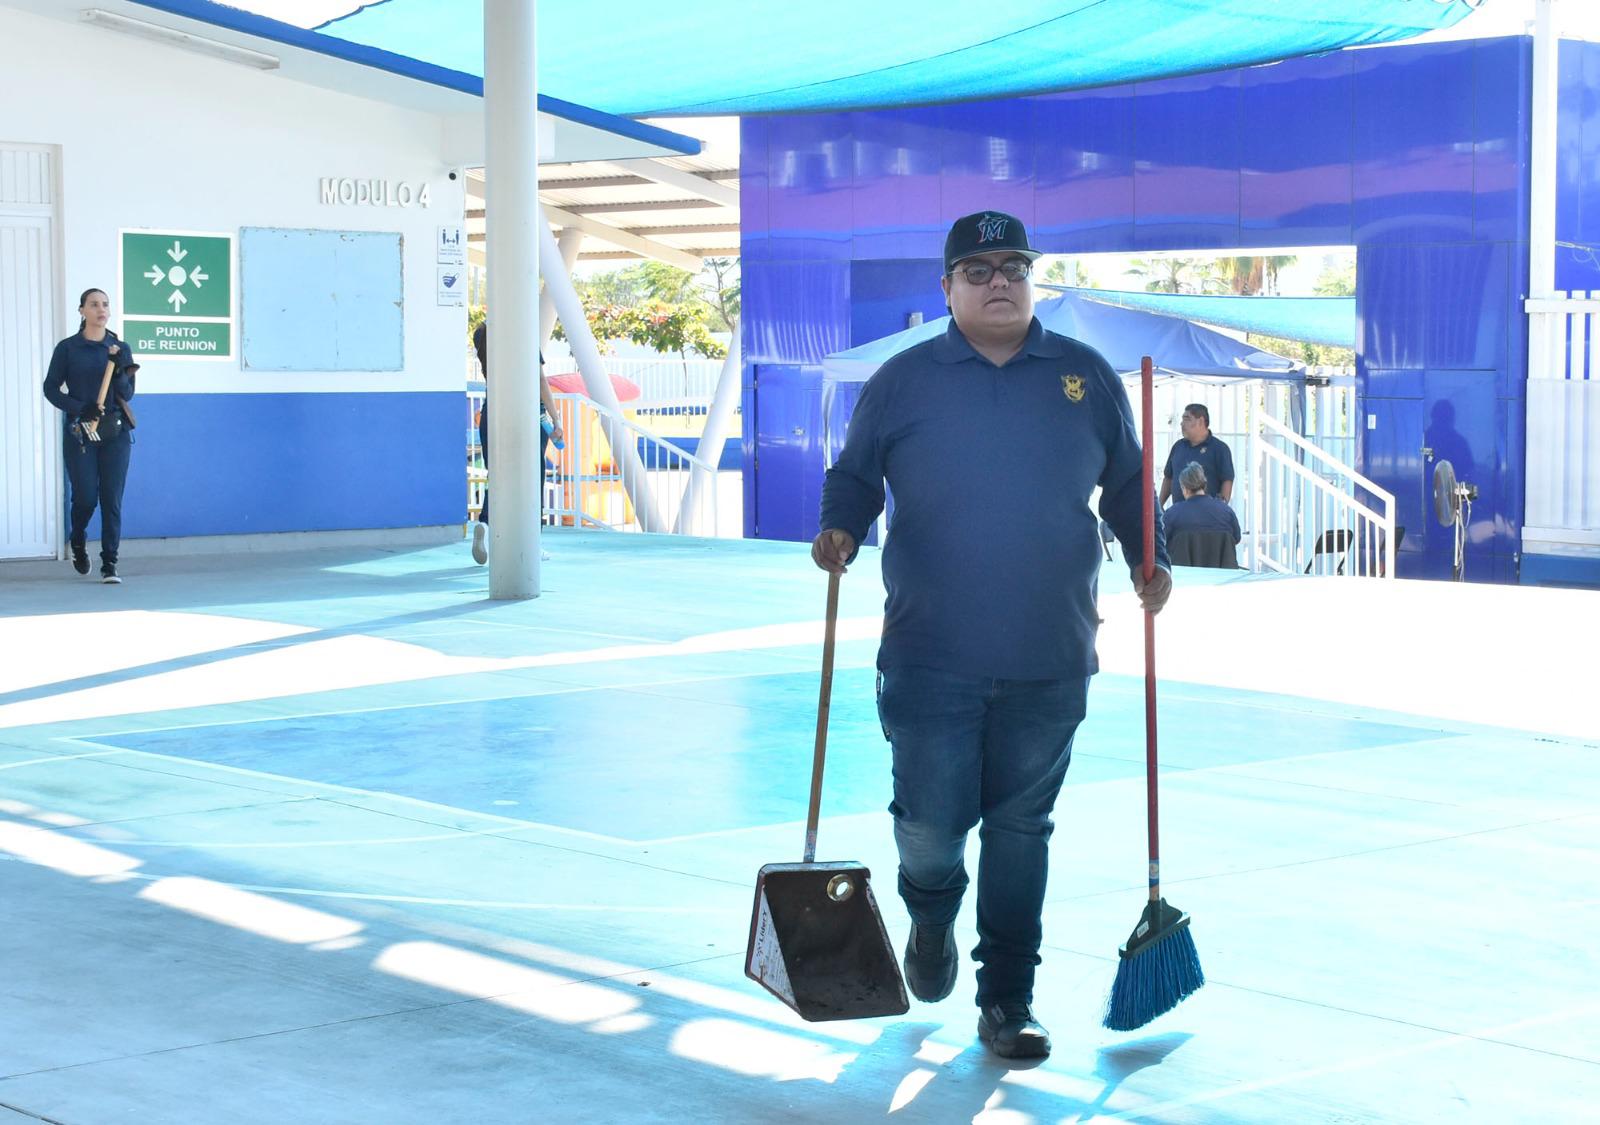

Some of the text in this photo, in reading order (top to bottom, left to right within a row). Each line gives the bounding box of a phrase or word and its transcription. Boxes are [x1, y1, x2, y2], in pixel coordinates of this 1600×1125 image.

[319, 178, 432, 209] MODULO 4
[156, 326, 200, 338] PUNTO
[138, 339, 217, 351] DE REUNION
